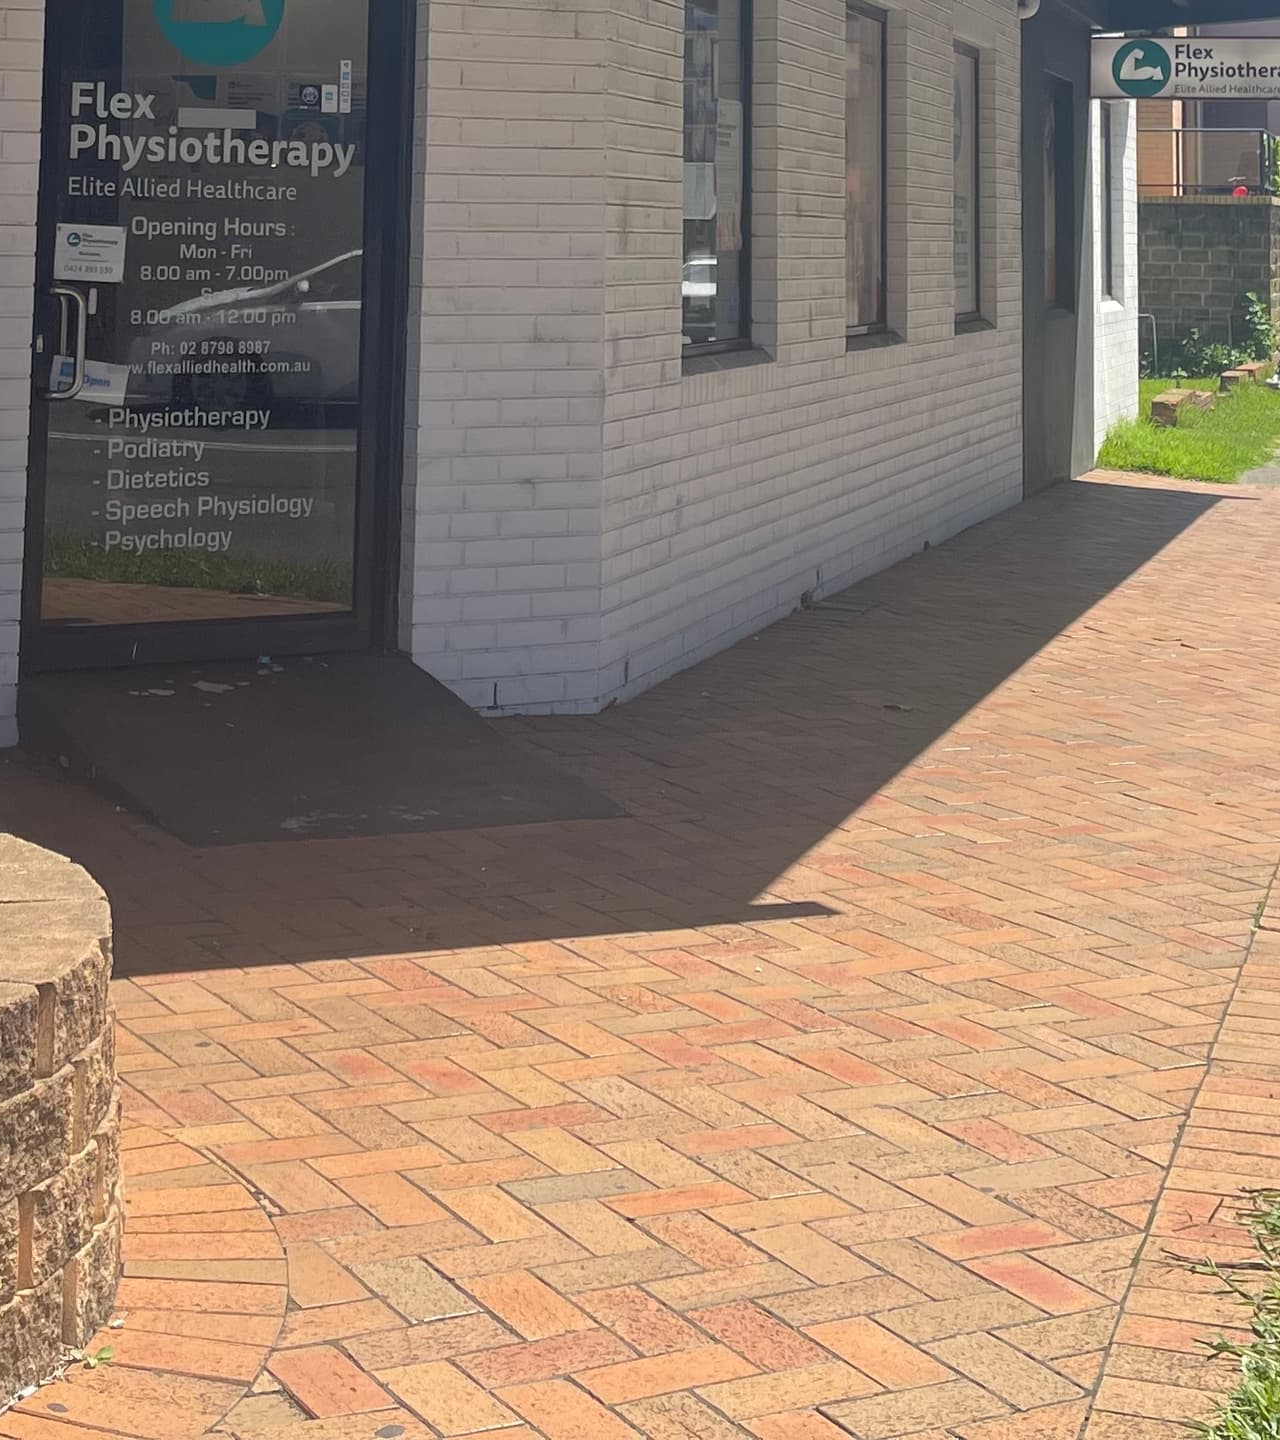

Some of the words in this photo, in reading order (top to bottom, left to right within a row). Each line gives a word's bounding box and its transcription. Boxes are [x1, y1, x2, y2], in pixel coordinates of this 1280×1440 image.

[1175, 44, 1214, 59] Flex
[1174, 84, 1197, 94] Elite
[1198, 84, 1227, 94] Allied
[69, 81, 156, 120] Flex
[68, 124, 355, 177] Physiotherapy
[68, 176, 116, 197] Elite
[121, 177, 180, 198] Allied
[187, 178, 297, 201] Healthcare
[131, 217, 217, 241] Opening
[180, 244, 217, 259] Mon
[231, 244, 253, 259] Fri
[140, 265, 181, 281] 8.00
[185, 269, 211, 281] am
[225, 265, 289, 285] 7.00pm
[130, 309, 170, 325] 8.00
[175, 312, 201, 325] am
[218, 309, 267, 325] 12.00
[271, 312, 297, 327] pm
[151, 341, 175, 356] Ph:
[180, 341, 197, 356] 02
[201, 340, 234, 355] 8798
[238, 340, 271, 355] 8987
[129, 359, 312, 375] w.flexalliedhealth.com.au
[108, 407, 272, 433] Physiotherapy
[107, 439, 205, 461] Podiatry
[107, 467, 210, 490] Dietetics
[105, 496, 190, 524] Speech
[197, 494, 314, 521] Physiology
[105, 528, 232, 555] Psychology
